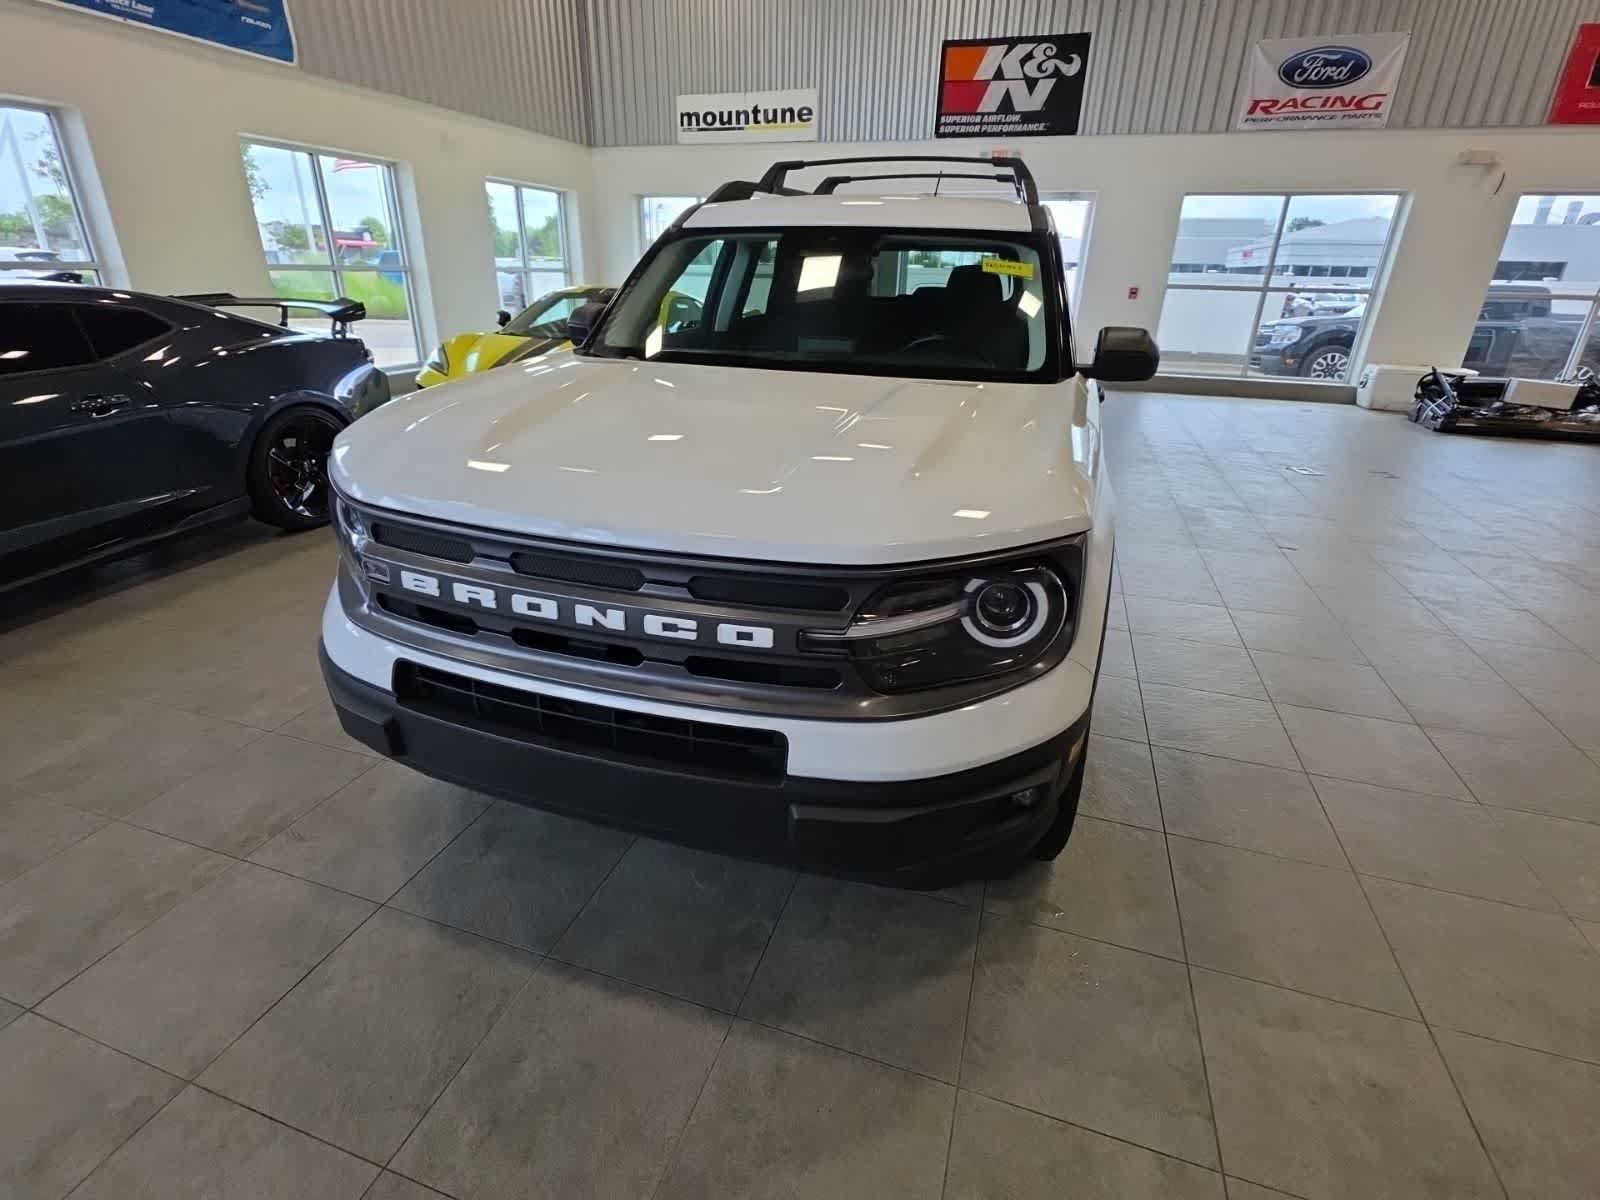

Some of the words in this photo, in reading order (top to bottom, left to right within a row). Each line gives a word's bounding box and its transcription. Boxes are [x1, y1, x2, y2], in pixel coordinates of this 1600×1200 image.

[1294, 53, 1354, 82] Ford
[1247, 94, 1387, 115] RACING
[680, 104, 813, 127] mountune
[940, 115, 981, 123] SUPERIOR
[982, 114, 1022, 122] AIRFLOW.
[1244, 114, 1337, 123] PERFORMANCE
[1341, 113, 1383, 121] PARTS
[939, 125, 980, 133] SUPERIOR
[400, 570, 774, 649] BRONCO
